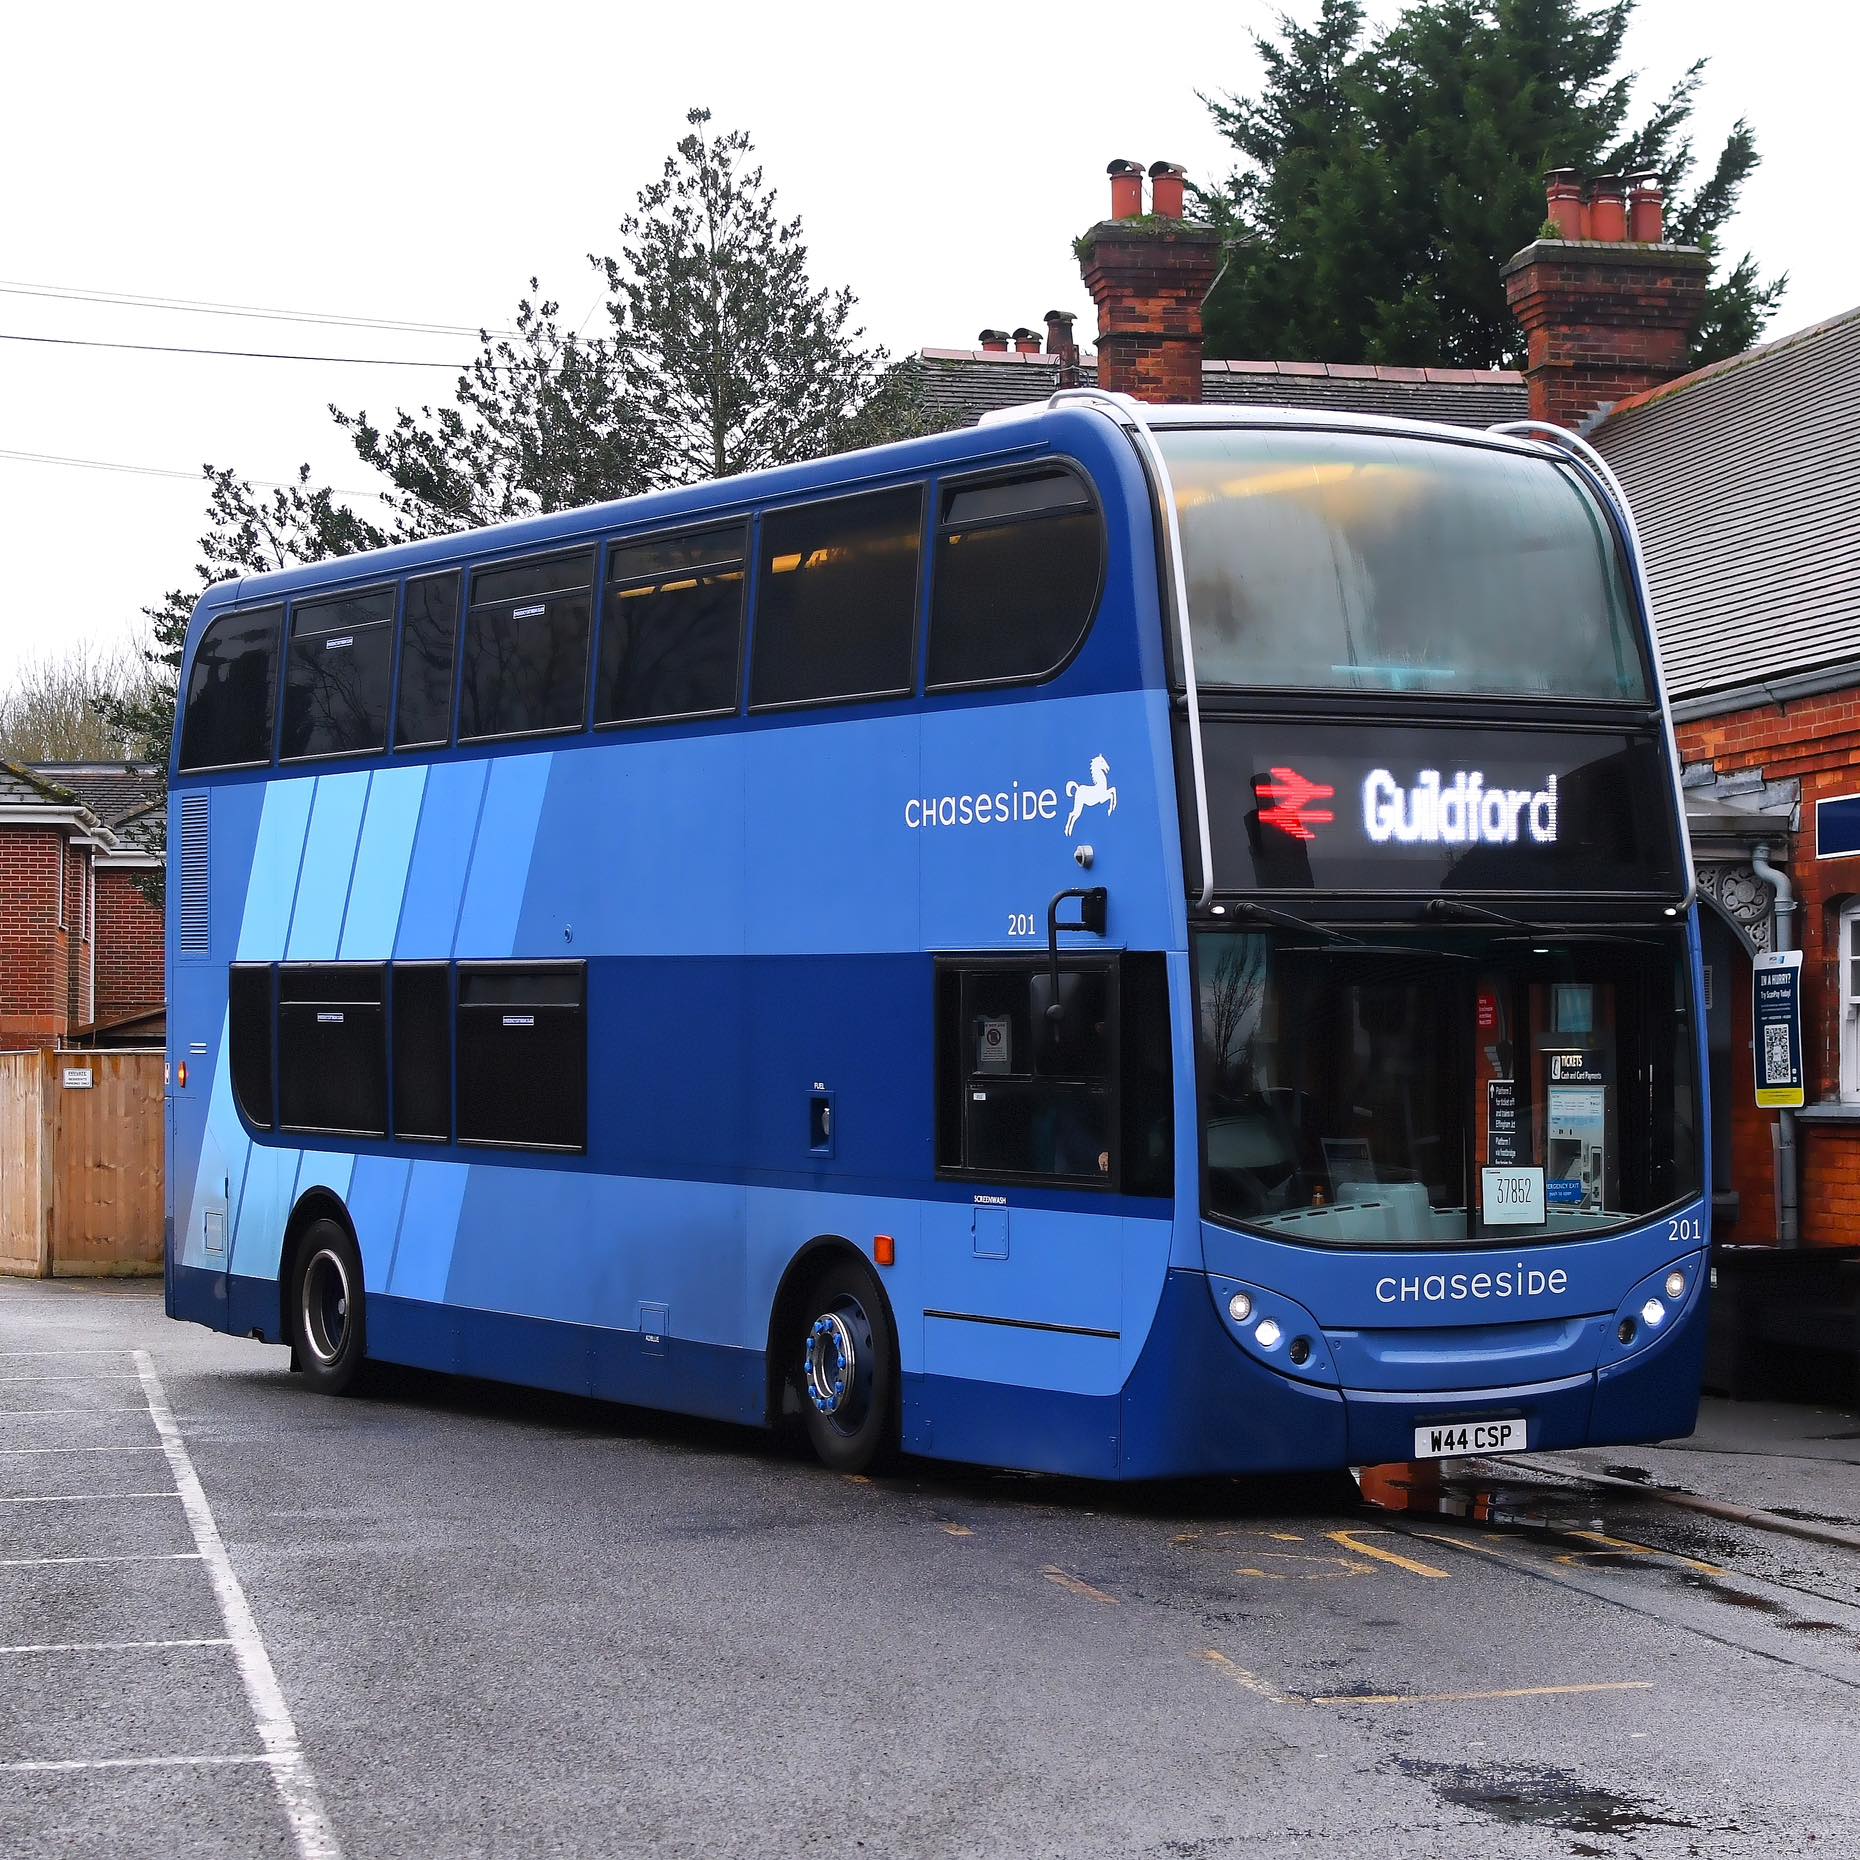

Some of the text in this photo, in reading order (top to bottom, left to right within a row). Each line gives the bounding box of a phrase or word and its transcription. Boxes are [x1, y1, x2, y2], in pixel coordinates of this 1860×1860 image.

[1362, 768, 1558, 843] Guildford
[1007, 913, 1036, 936] 201
[1760, 973, 1791, 986] IN A HURRY?
[1561, 1055, 1582, 1067] TICKETS
[1561, 1071, 1570, 1080] Cash
[1585, 1071, 1602, 1082] Payments
[974, 1195, 1006, 1204] SCREENWASH
[1496, 1178, 1532, 1204] 37852
[1668, 1218, 1701, 1241] 201
[1430, 1425, 1512, 1453] W44 CSP
